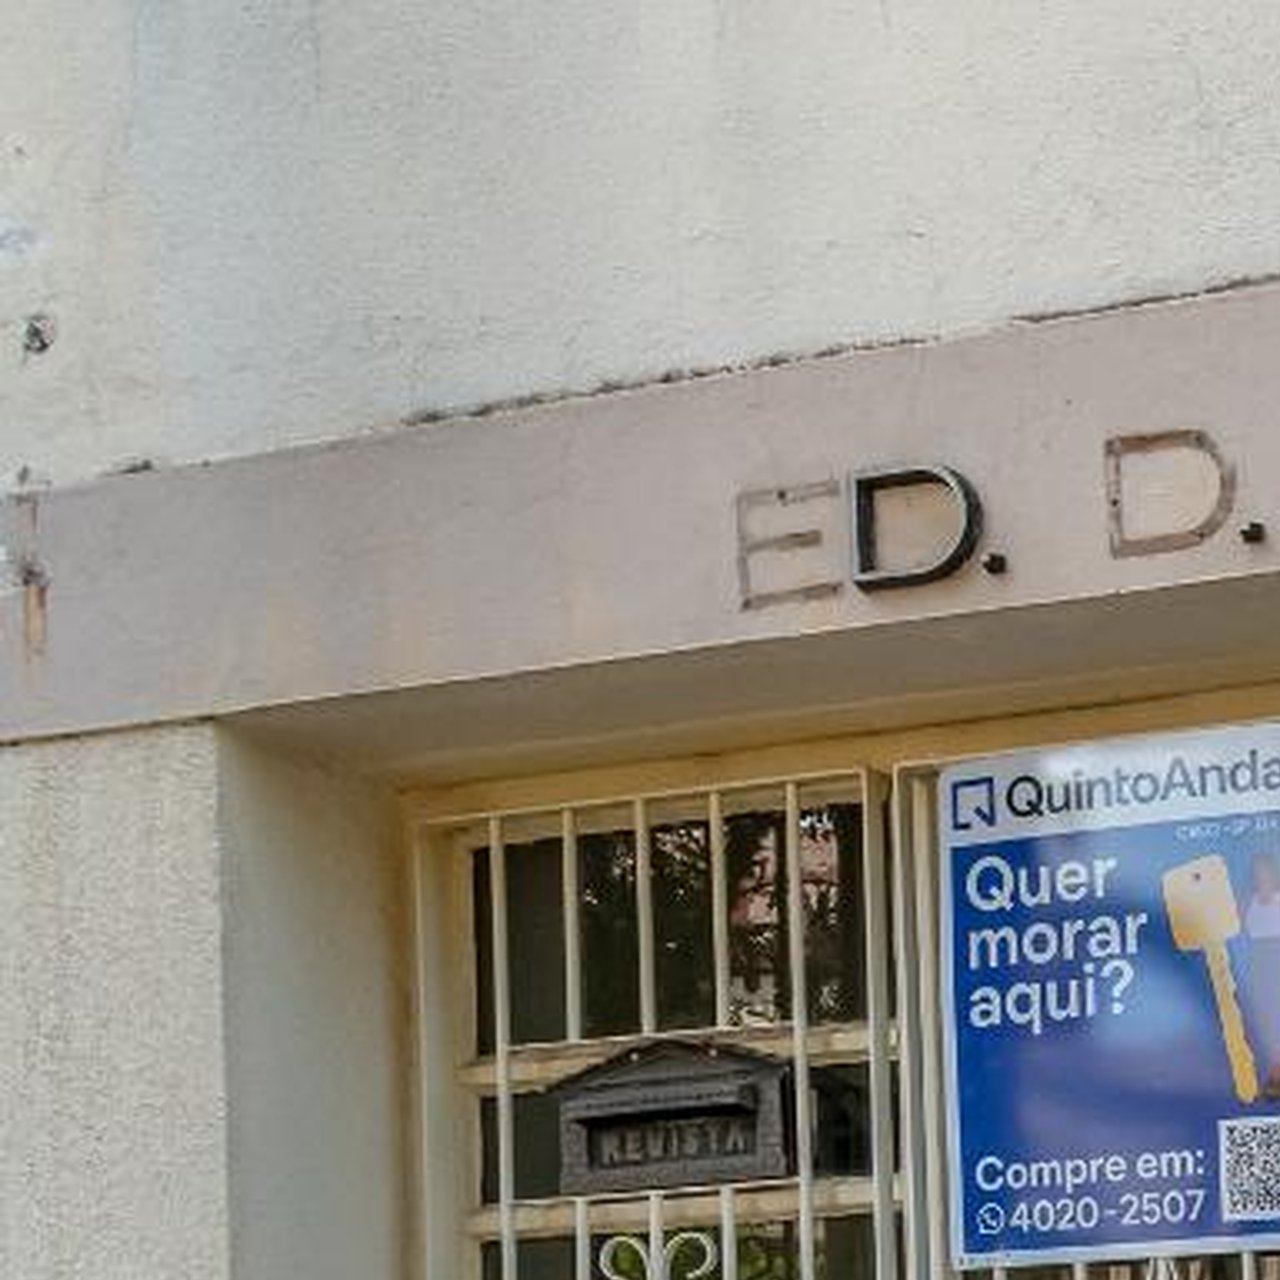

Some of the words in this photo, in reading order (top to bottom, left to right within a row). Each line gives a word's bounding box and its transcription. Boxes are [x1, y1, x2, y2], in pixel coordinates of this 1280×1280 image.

[1105, 429, 1267, 559] D.
[965, 855, 1118, 912] Quer
[968, 912, 1148, 971] morar
[968, 960, 1135, 1035] aqui?
[601, 1120, 745, 1165] REVISTA
[975, 1155, 1127, 1196] Compre
[1136, 1147, 1206, 1184] em:
[1008, 1189, 1206, 1233] 4020-2507
